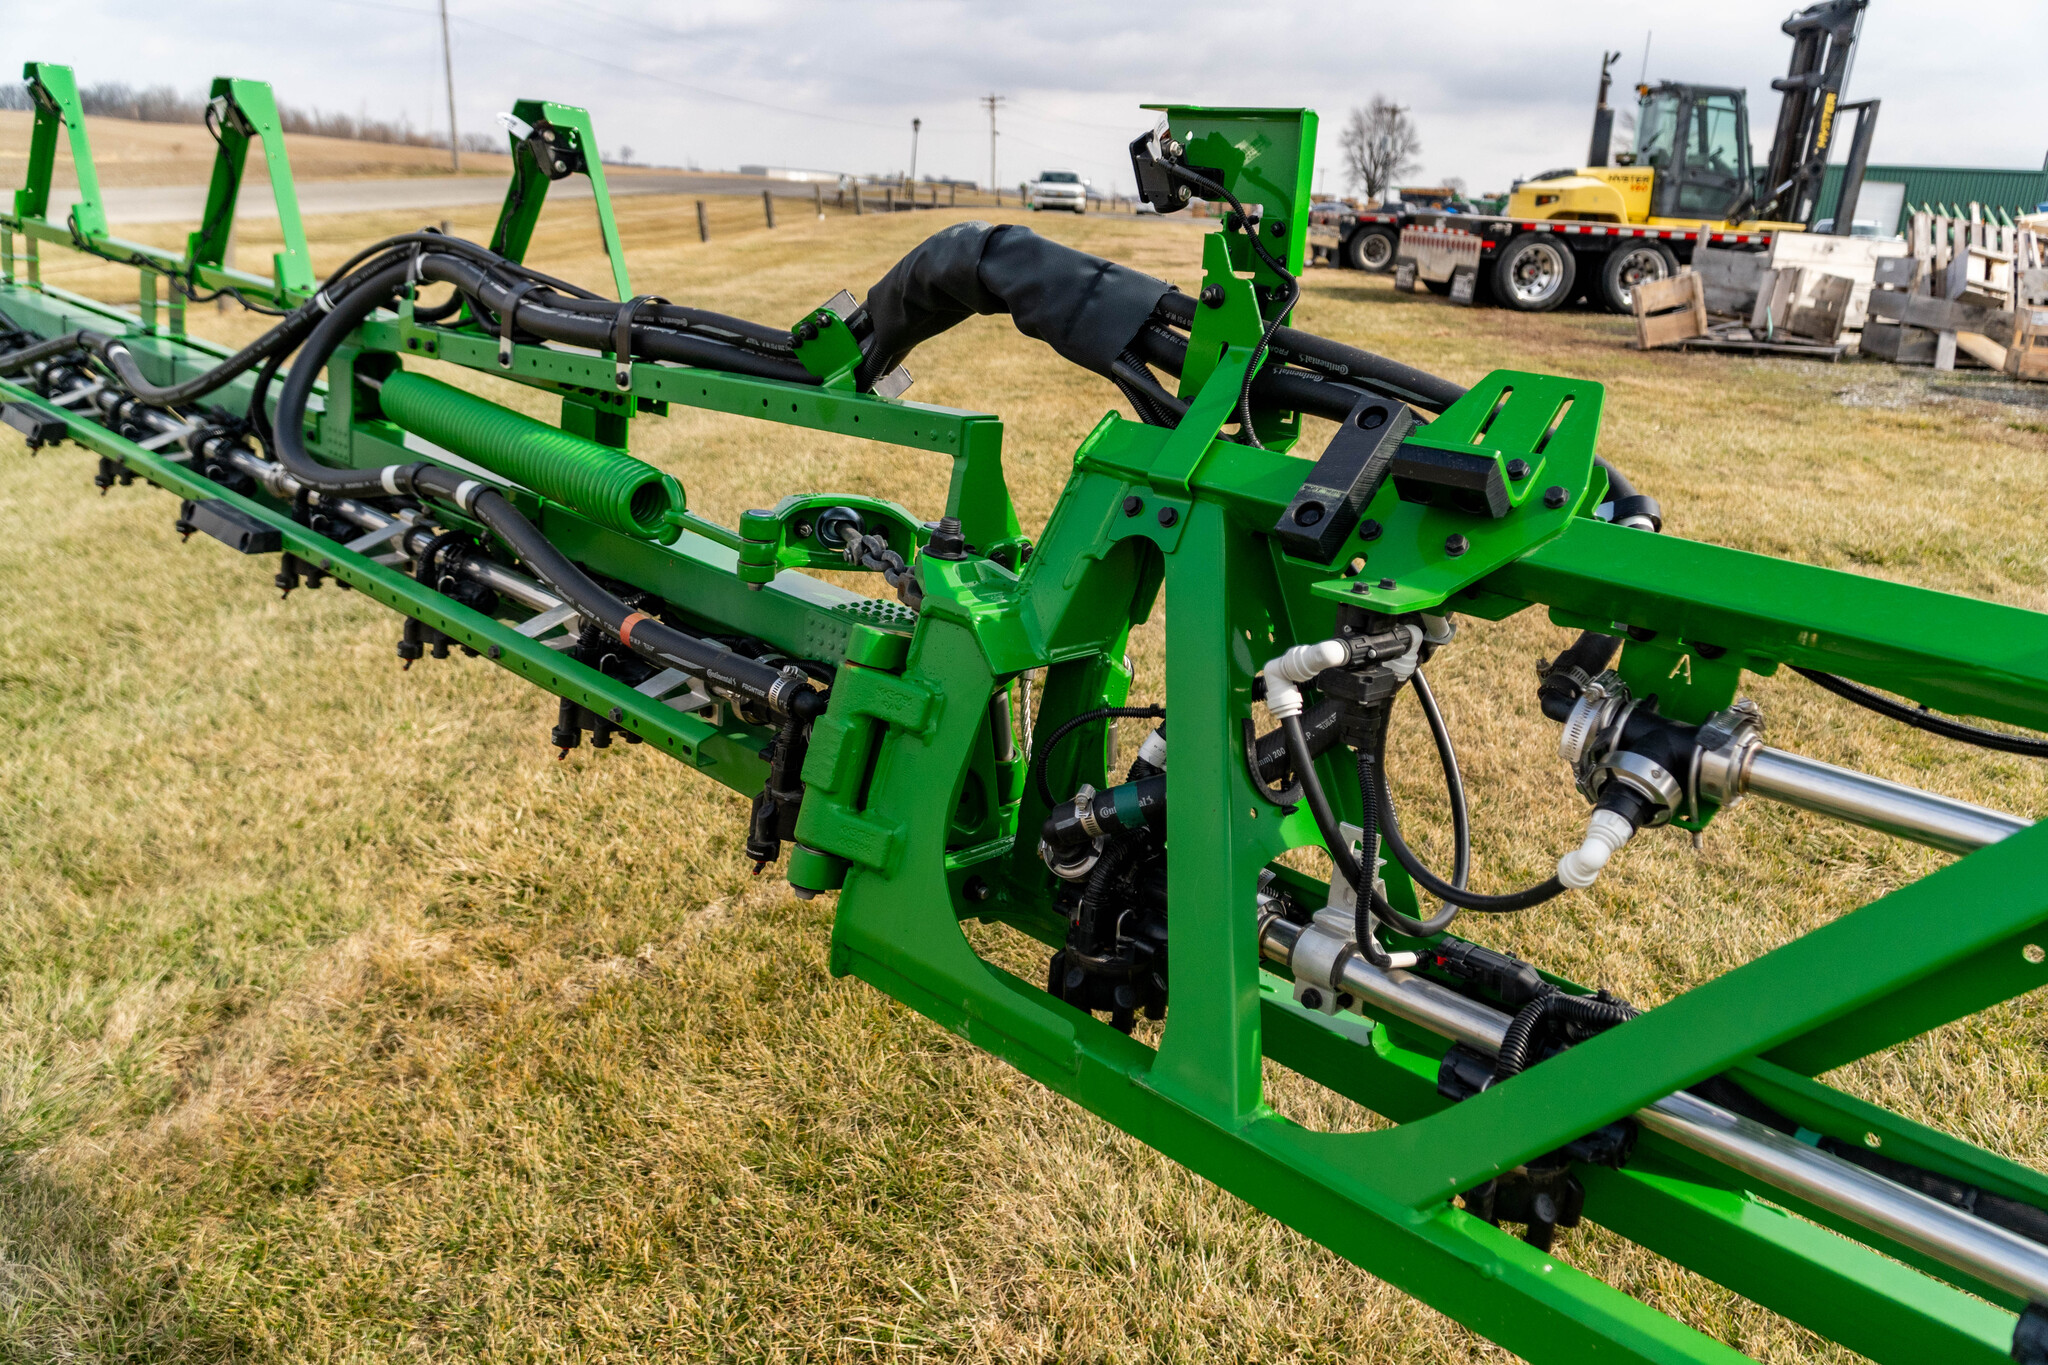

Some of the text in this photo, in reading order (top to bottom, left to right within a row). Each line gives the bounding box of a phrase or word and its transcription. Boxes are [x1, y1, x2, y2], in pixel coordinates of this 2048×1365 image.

[1304, 354, 1349, 376] Continental
[1279, 367, 1325, 382] Continental
[1668, 653, 1692, 685] A
[1272, 747, 1286, 759] 200
